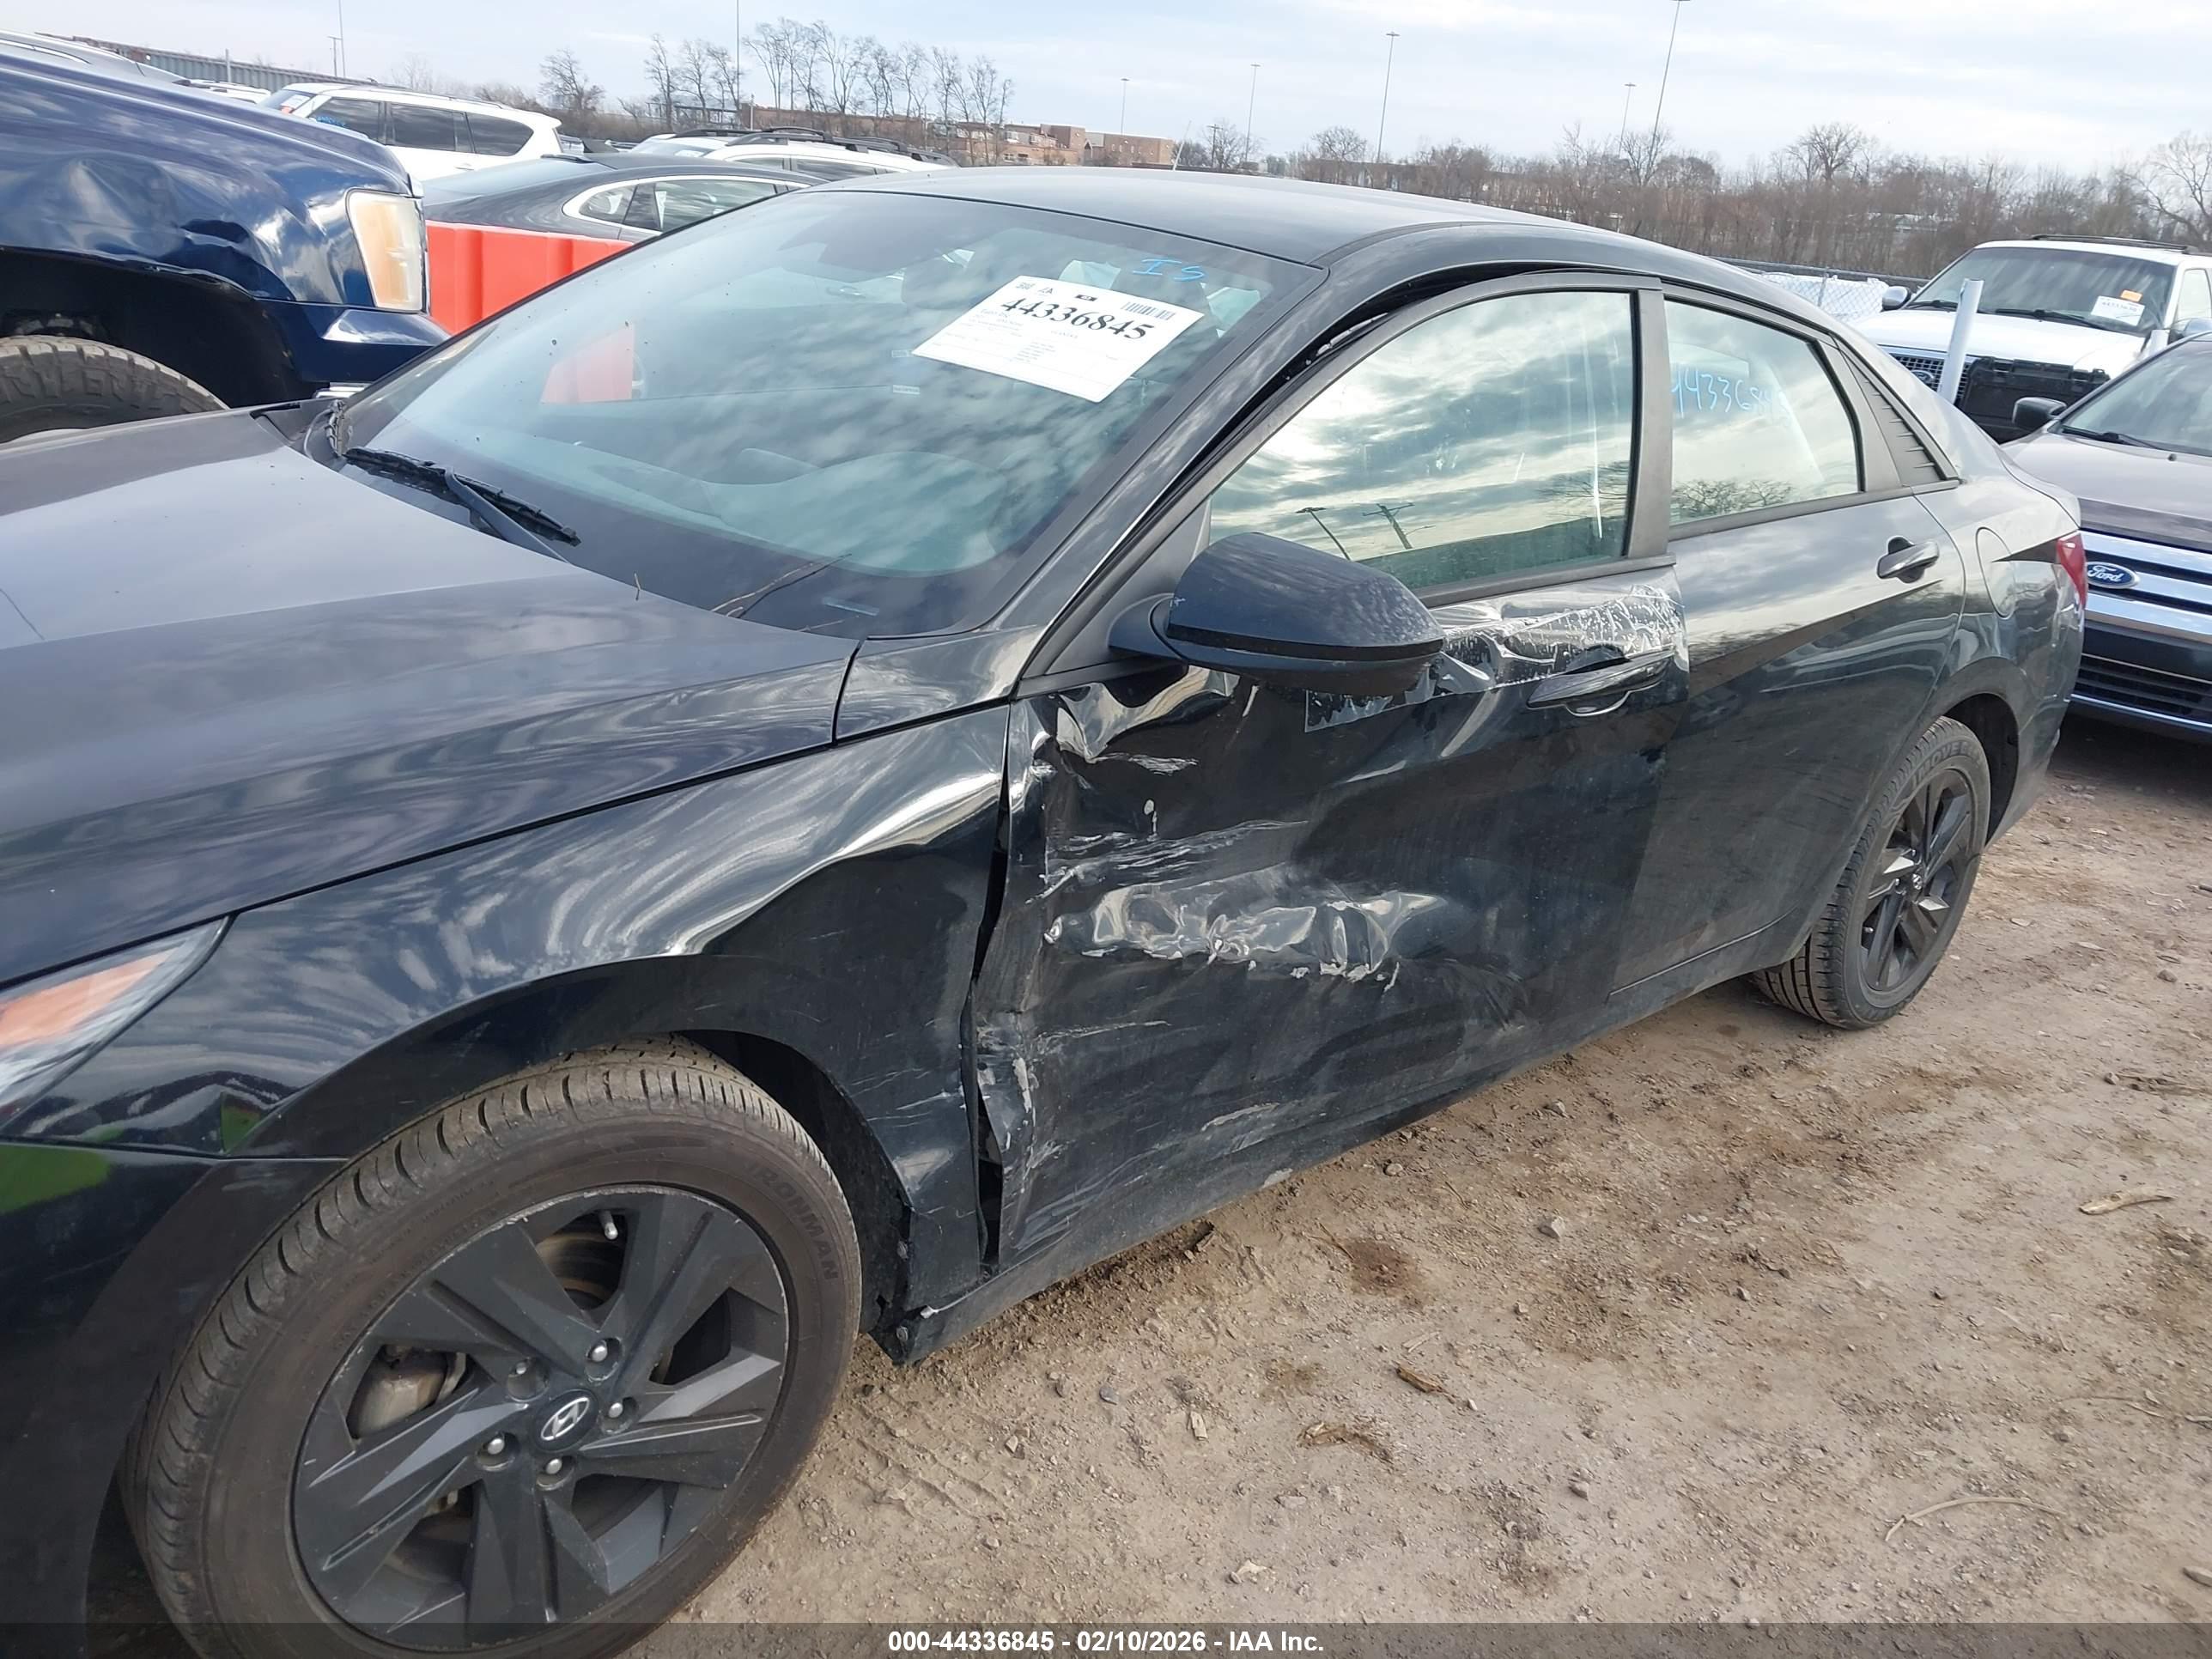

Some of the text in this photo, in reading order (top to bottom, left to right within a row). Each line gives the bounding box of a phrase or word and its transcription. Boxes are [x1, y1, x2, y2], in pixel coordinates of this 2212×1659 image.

[1000, 297, 1156, 340] 44336845
[1671, 365, 1790, 425] 443368
[2087, 564, 2124, 582] Ford
[745, 1162, 840, 1280] IRONMAN
